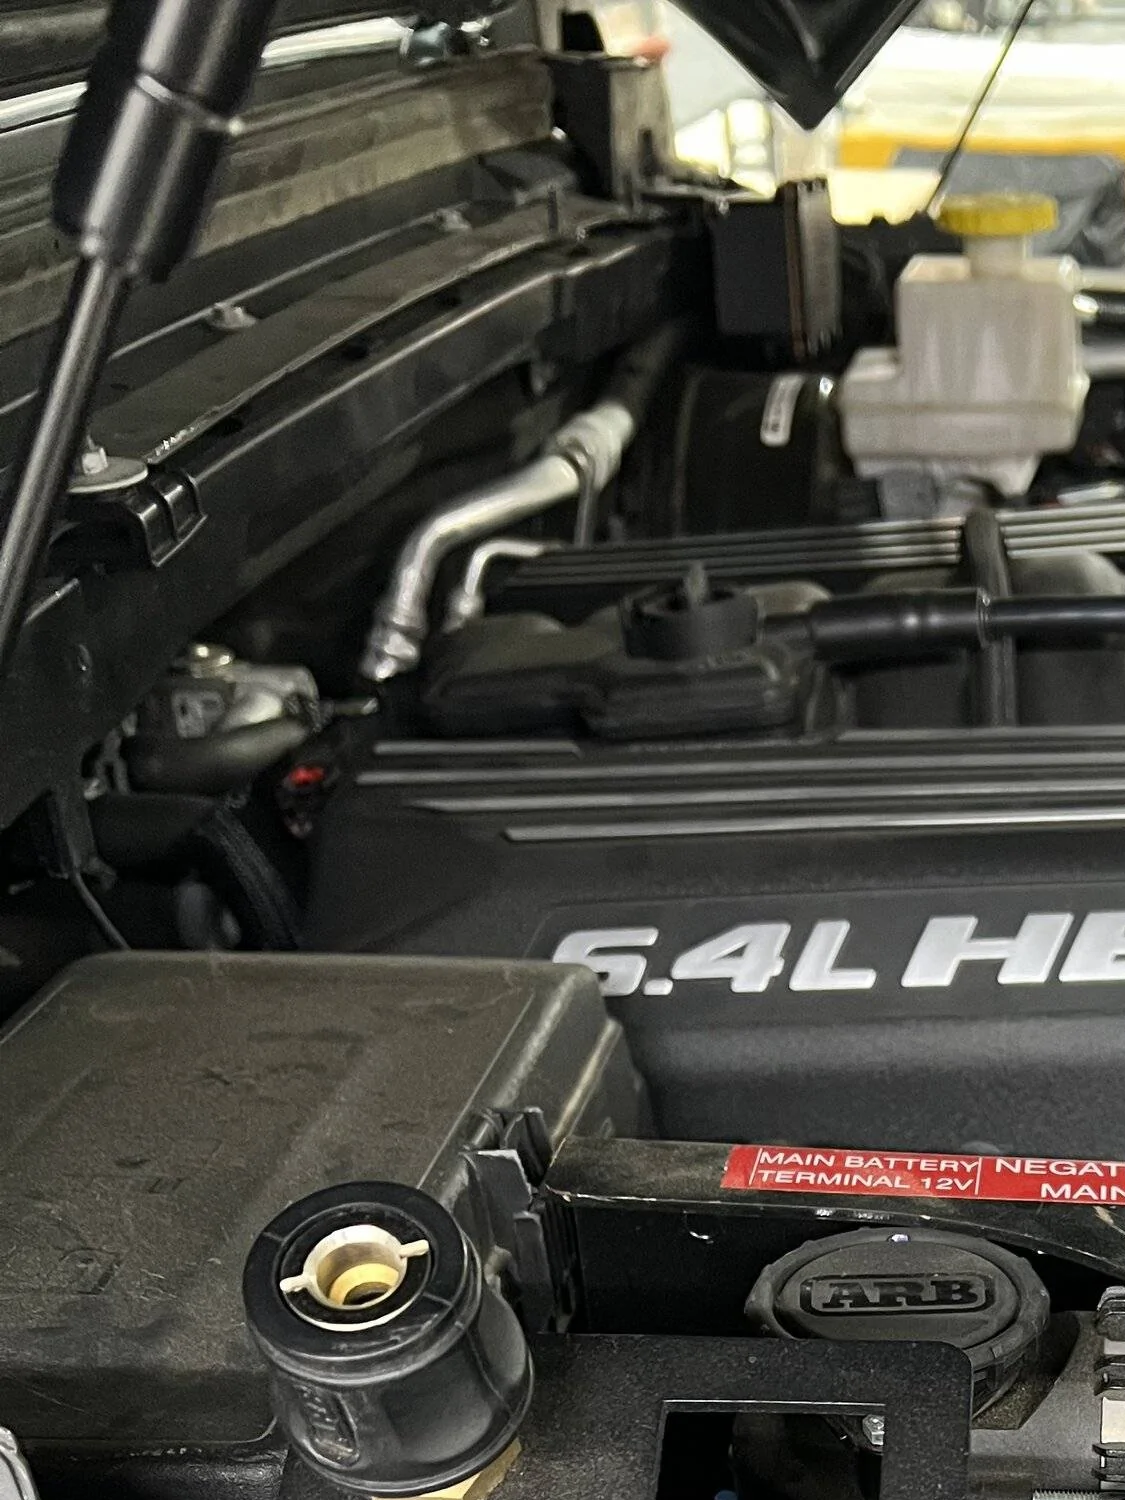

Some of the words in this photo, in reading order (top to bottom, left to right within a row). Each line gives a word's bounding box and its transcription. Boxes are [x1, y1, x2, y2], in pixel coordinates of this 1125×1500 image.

[759, 1151, 836, 1168] MAIN
[843, 1154, 980, 1173] BATTERY
[757, 1169, 911, 1189] TERMINAL
[921, 1177, 975, 1192] 12V
[820, 1278, 980, 1310] ARB
